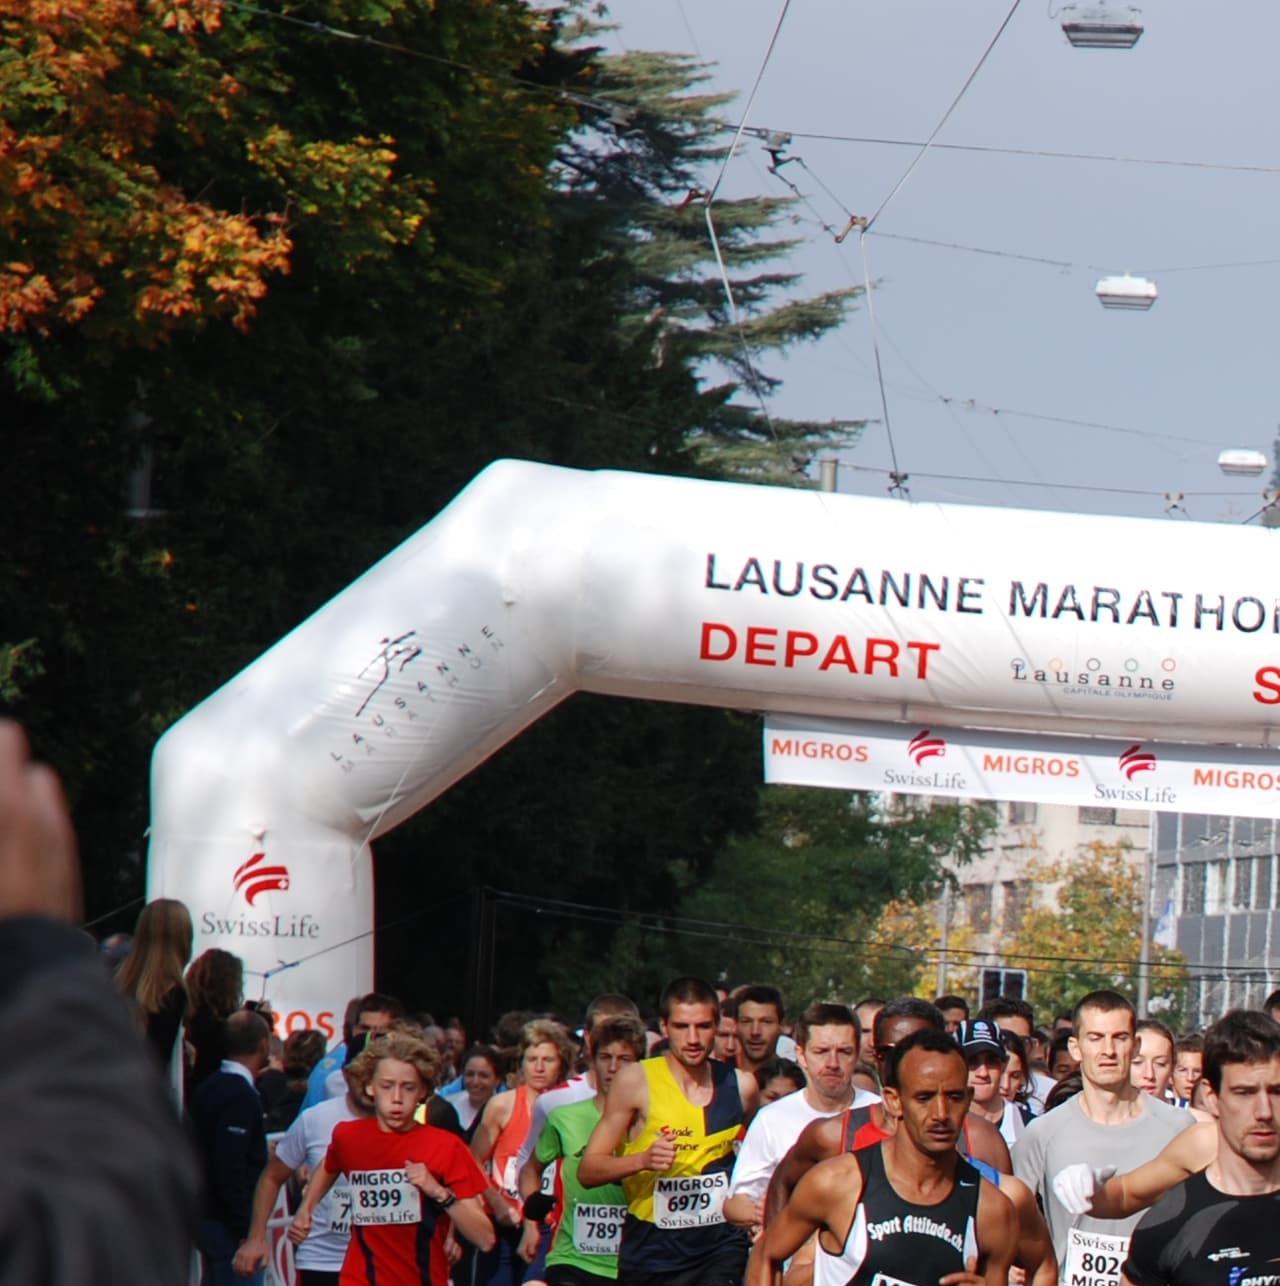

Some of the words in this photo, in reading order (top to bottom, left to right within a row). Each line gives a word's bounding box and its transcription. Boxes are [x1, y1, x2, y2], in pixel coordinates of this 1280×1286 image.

[705, 553, 985, 615] LAUSANNE
[699, 622, 940, 681] DEPART
[1012, 664, 1175, 690] Lausanne
[771, 738, 869, 762] MIGROS
[983, 753, 1080, 777] MIGROS
[883, 769, 967, 790] SwissLife
[1094, 783, 1178, 804] SwissLife
[200, 911, 320, 939] SwissLife
[657, 1175, 724, 1193] MIGROS
[360, 1188, 402, 1208] 8399
[668, 1192, 711, 1212] 6979
[355, 1211, 387, 1223] Swiss
[390, 1209, 415, 1222] Life
[577, 1205, 628, 1219] MIGRO
[660, 1215, 695, 1227] Swiss
[699, 1213, 722, 1225] Life
[586, 1222, 623, 1239] 789
[867, 1216, 901, 1241] Sport
[1072, 1232, 1115, 1252] Swiss
[1082, 1252, 1119, 1275] 802
